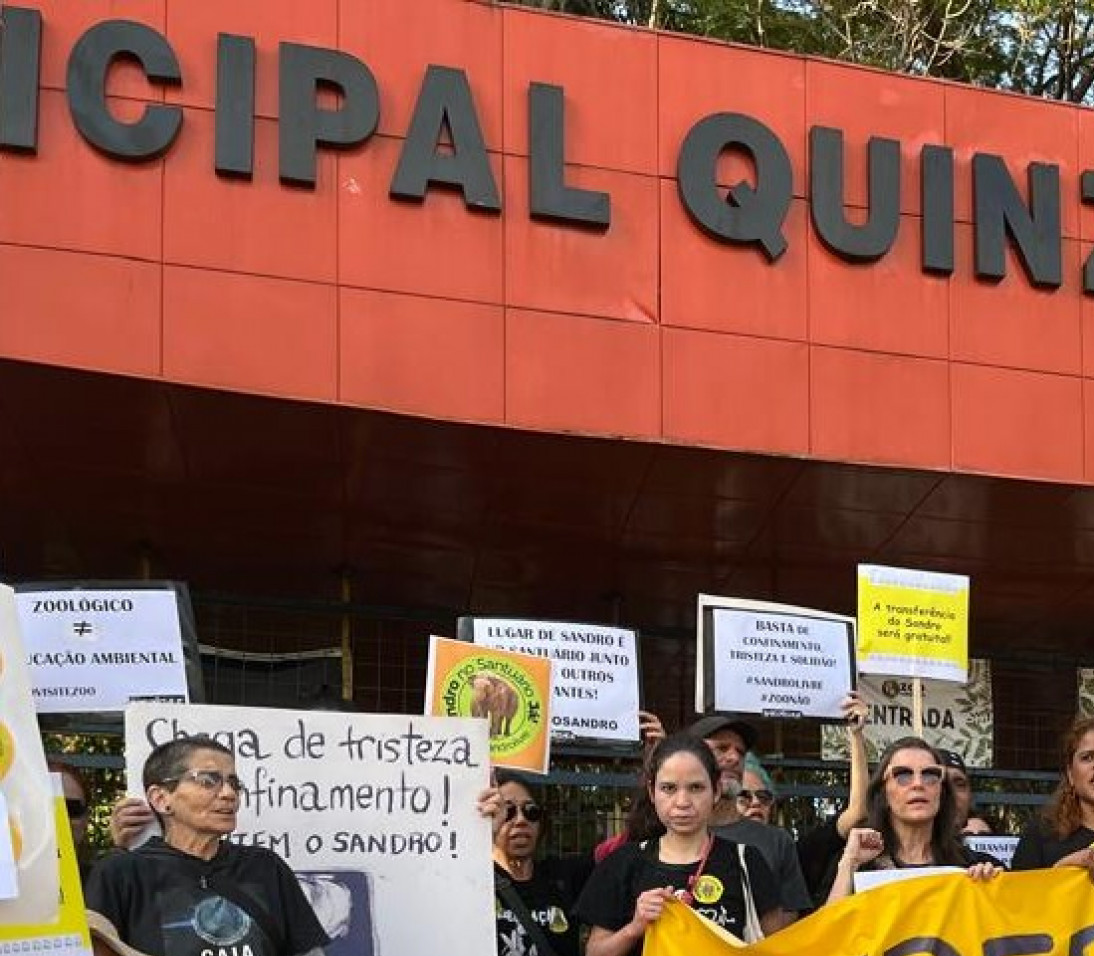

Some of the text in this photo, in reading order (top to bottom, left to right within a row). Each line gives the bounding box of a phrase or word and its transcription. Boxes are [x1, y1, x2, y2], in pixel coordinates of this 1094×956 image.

[32, 597, 134, 614] ZOOLÓGICO
[873, 603, 881, 612] A
[756, 620, 794, 633] BASTA
[905, 618, 942, 631] Sandro
[488, 627, 614, 646] LUGAR DE SANDRO
[877, 629, 901, 639] será
[91, 651, 178, 665] AMBIENTAL
[590, 652, 630, 666] JUNTO
[730, 650, 779, 662] TRISTEZA
[561, 668, 614, 683] OUTROS
[746, 676, 823, 689] #SANDROLIVRE
[285, 719, 326, 759] de
[338, 721, 480, 767] tristeza
[306, 835, 323, 854] O
[332, 831, 458, 859] SANDRO!
